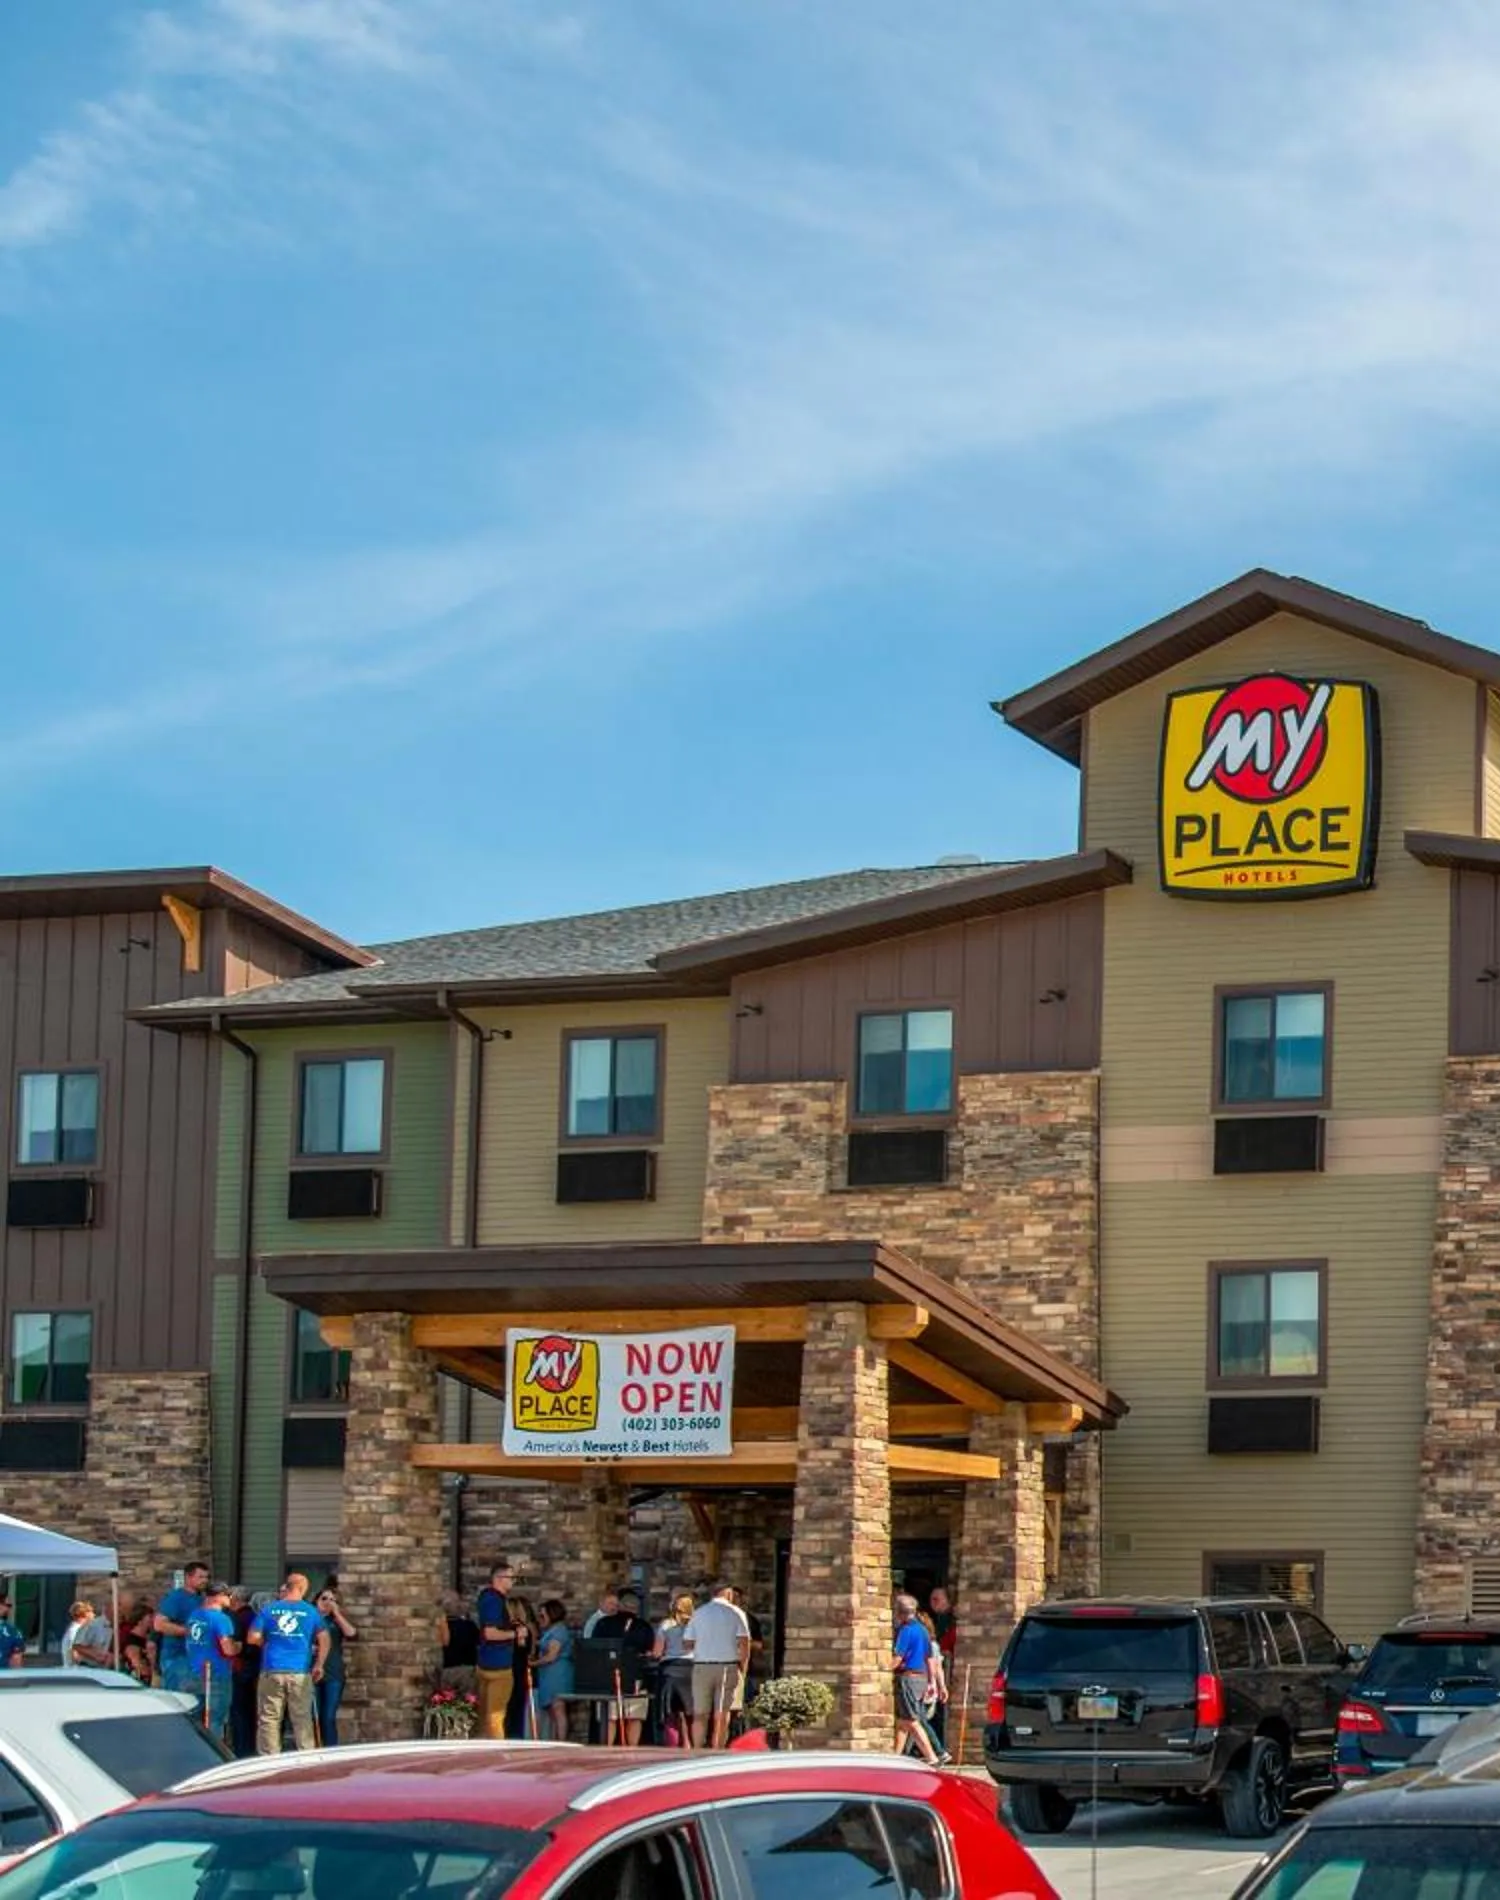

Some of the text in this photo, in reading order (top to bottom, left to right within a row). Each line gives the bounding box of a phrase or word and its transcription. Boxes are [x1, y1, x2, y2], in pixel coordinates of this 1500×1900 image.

[1173, 806, 1351, 859] PLACE
[1223, 869, 1298, 885] HOTELS
[625, 1341, 724, 1376] NOW
[519, 1395, 593, 1416] PLACE
[620, 1381, 723, 1414] OPEN
[622, 1417, 657, 1432] (402)
[523, 1438, 710, 1453] America's Newest & Best Hotels
